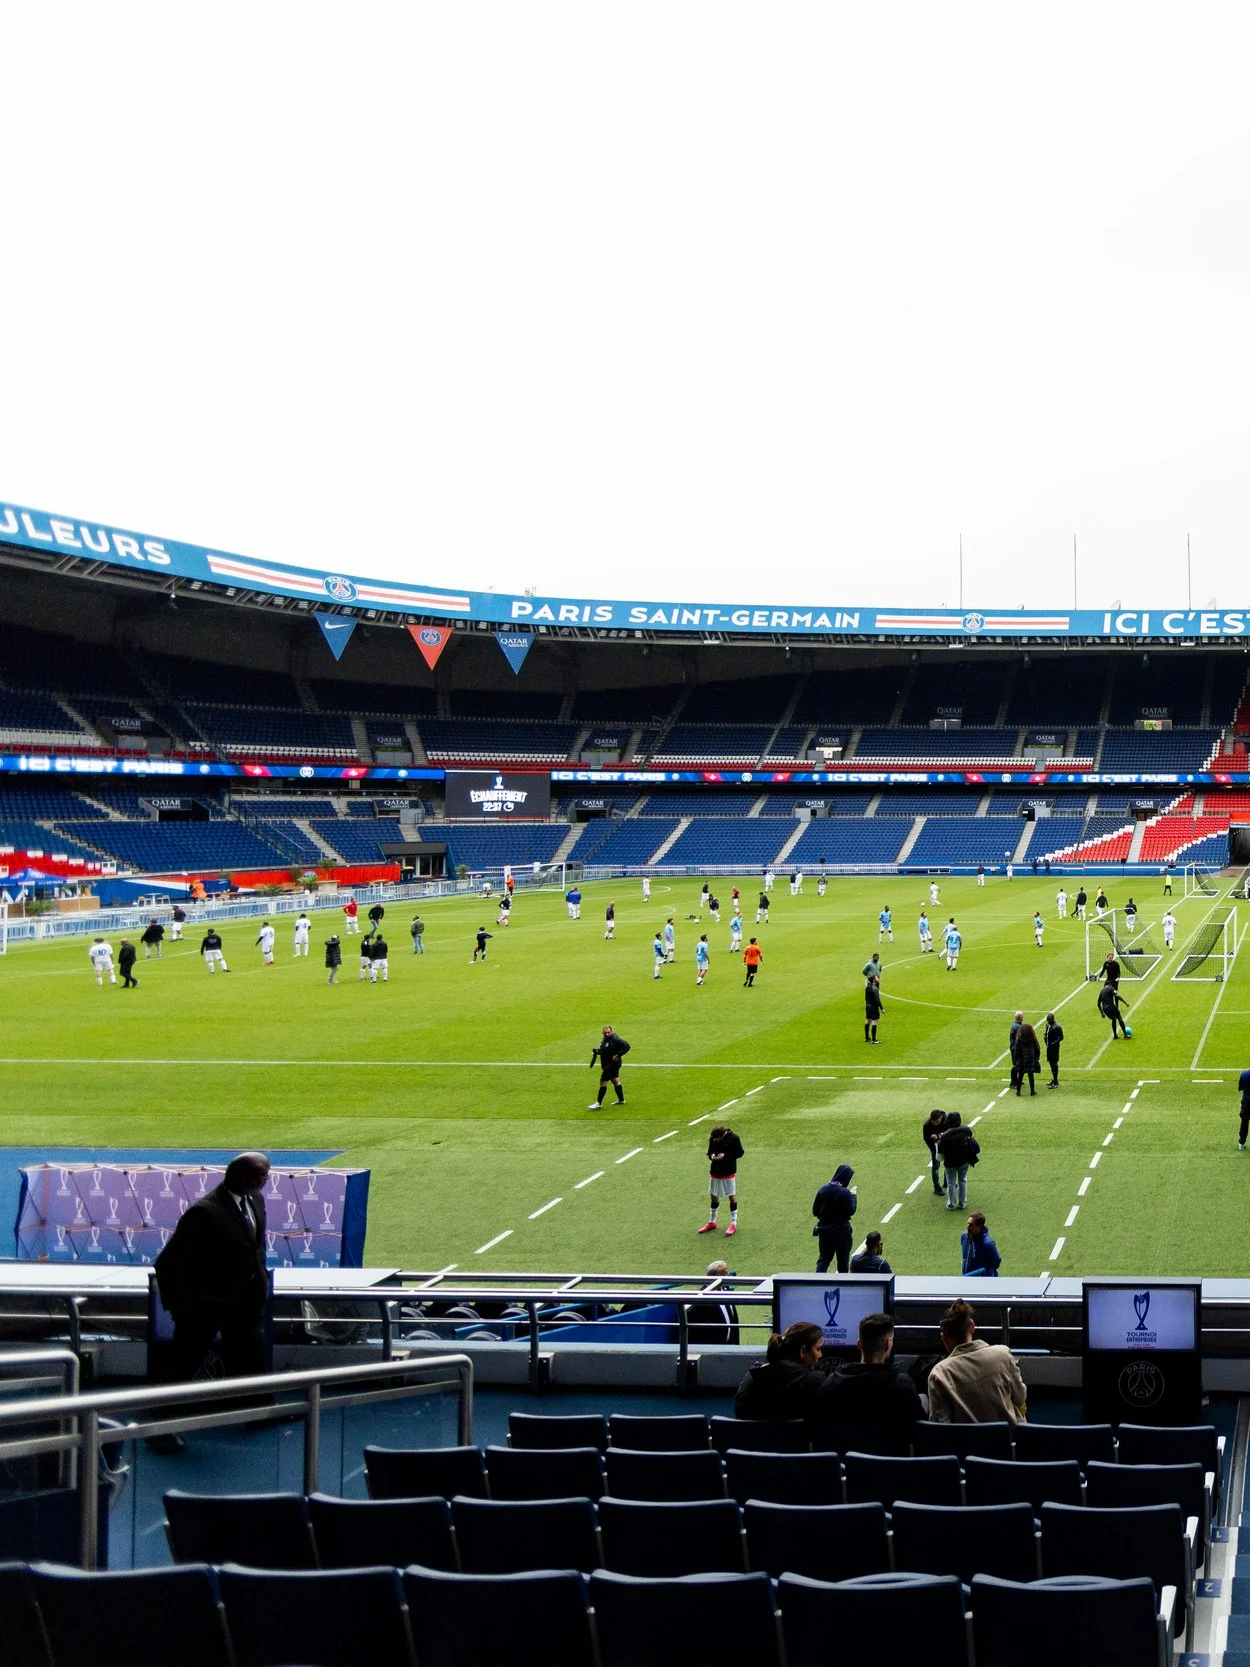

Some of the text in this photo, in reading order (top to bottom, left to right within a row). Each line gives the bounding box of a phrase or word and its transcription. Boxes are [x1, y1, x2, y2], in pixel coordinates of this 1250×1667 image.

[512, 601, 860, 629] PARIS SAINT-GERMAIN
[1103, 613, 1150, 633] ICI
[122, 760, 183, 774] PARIS
[624, 772, 666, 781] PARIS
[890, 773, 928, 781] PARIS
[1141, 774, 1177, 782] PARIS
[1125, 1363, 1156, 1375] PARIS
[1204, 1582, 1215, 1593] 2
